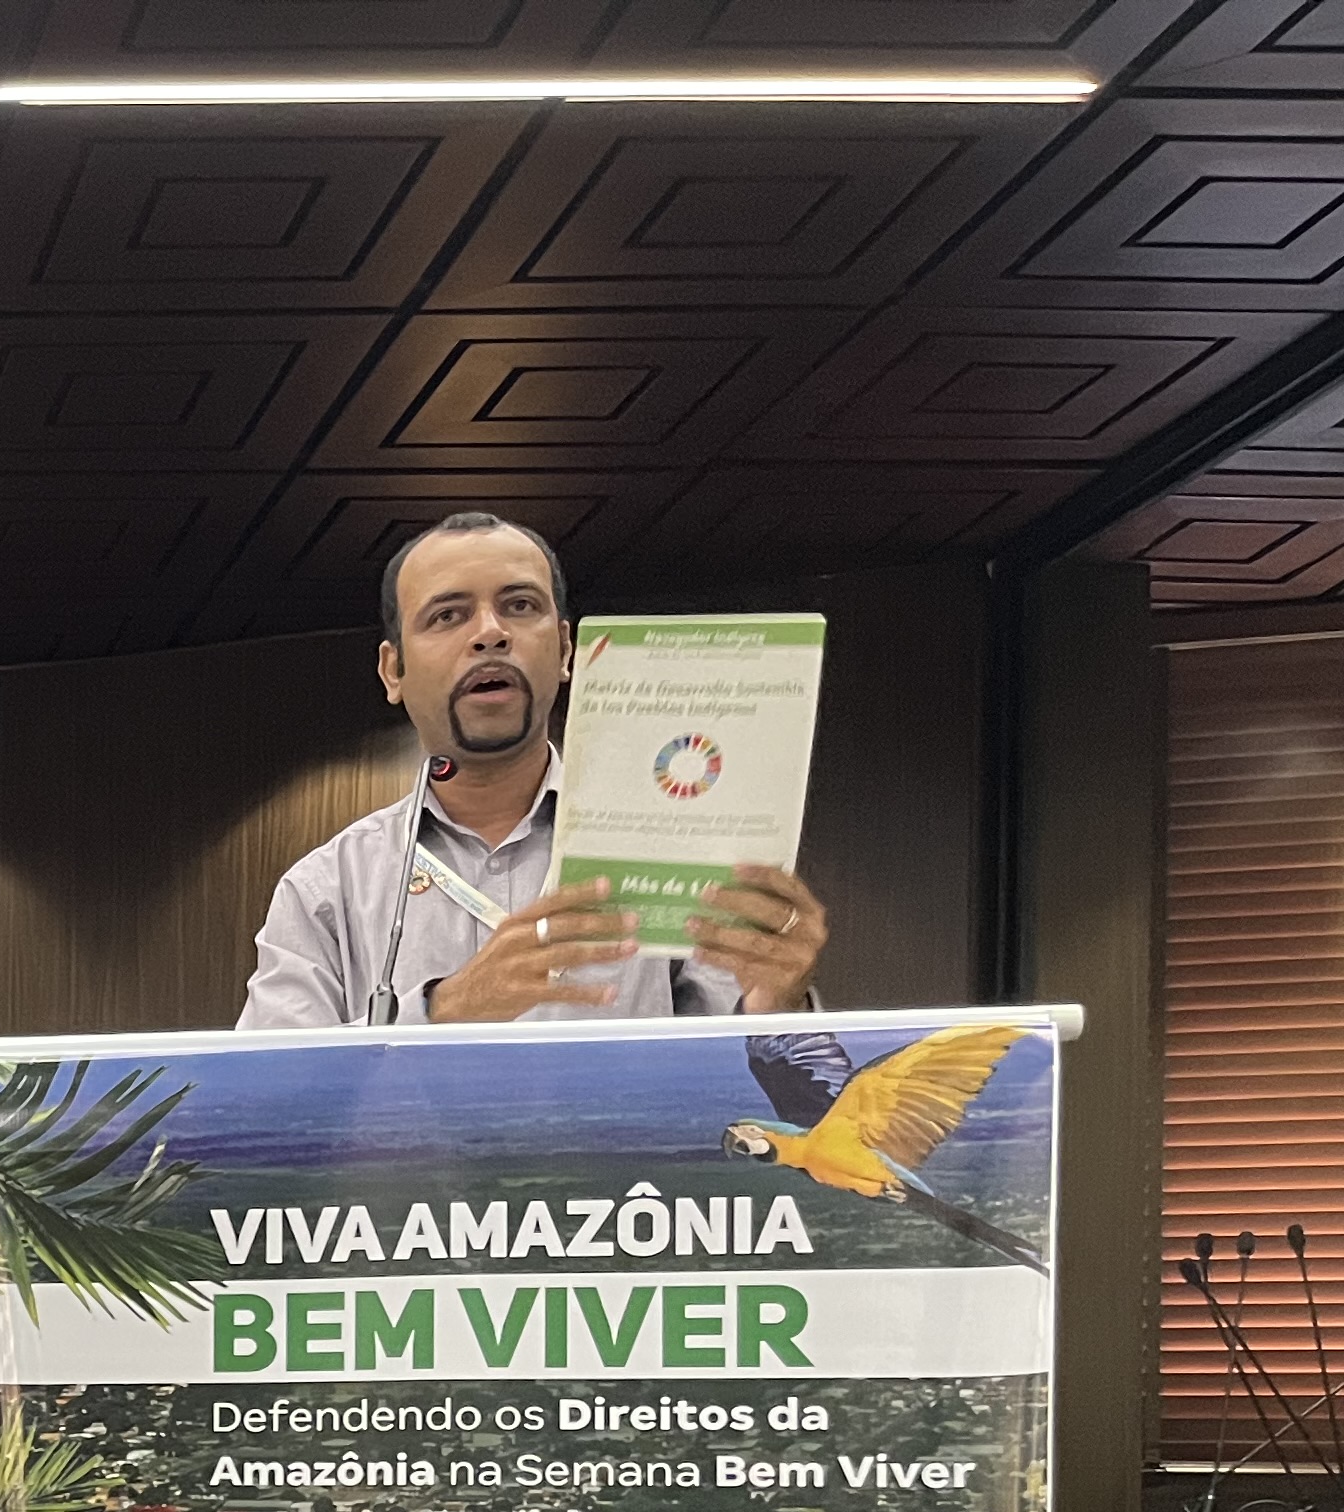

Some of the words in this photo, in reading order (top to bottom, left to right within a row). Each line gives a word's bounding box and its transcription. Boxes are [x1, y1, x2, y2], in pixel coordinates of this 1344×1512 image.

[209, 1205, 386, 1265] VIVA
[392, 1181, 815, 1260] AMAZÔNIA
[213, 1289, 435, 1373] BEM
[457, 1284, 816, 1369] VIVER
[212, 1397, 482, 1433] Defendendo
[494, 1404, 545, 1431] os
[558, 1396, 755, 1432] Direitos
[767, 1396, 830, 1432] da
[209, 1450, 436, 1487] Amazônia
[449, 1460, 502, 1486] na
[515, 1453, 701, 1488] Semana
[715, 1455, 825, 1488] Bem
[837, 1453, 977, 1490] Viver
